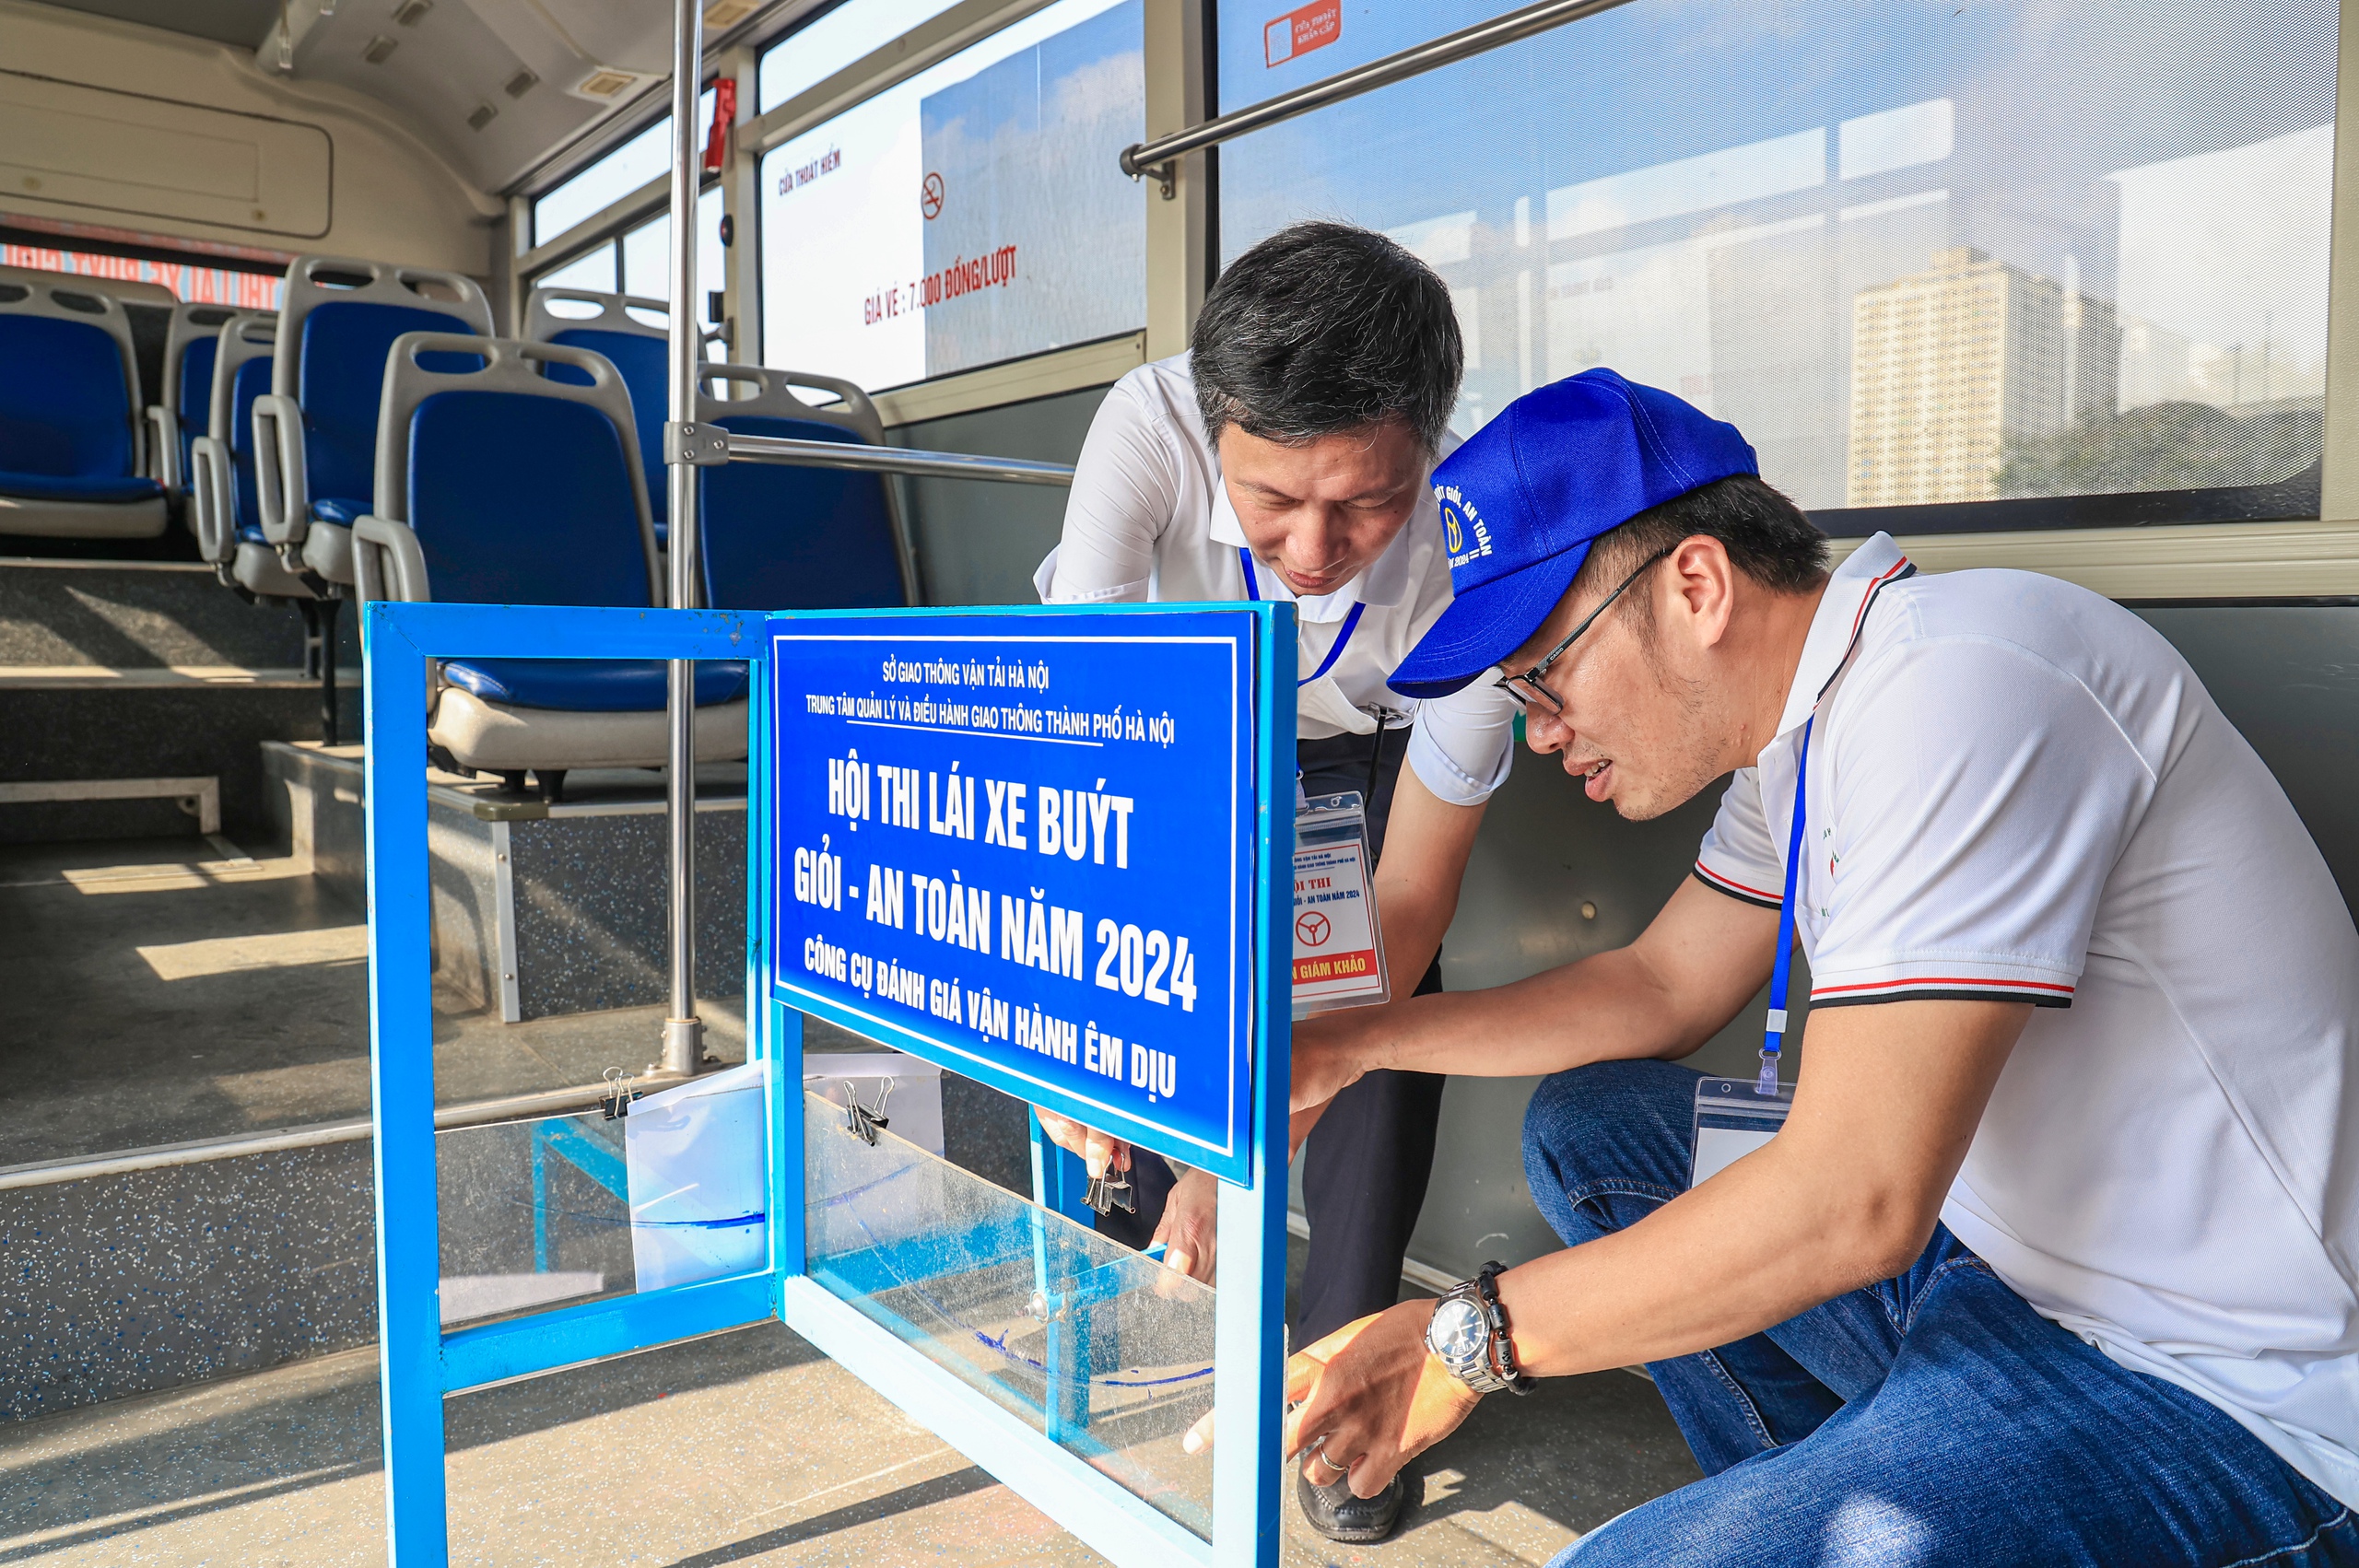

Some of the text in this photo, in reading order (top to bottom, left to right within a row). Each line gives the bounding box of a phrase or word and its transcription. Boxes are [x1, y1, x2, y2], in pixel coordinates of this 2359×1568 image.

[864, 287, 882, 325] GIÁ
[909, 273, 941, 310] 7.000
[1462, 500, 1478, 522] AN
[1473, 519, 1493, 556] TOÀN
[1454, 553, 1470, 568] 2024
[883, 653, 1050, 695] SỞ GIAO THÔNG VẬN TẢI HÀ NỘI
[805, 691, 1175, 749] TRUNG TÂM QUẢN LÝ VÀ ĐIỀU HÀNH GIAO THÔNG THÀNH PHỐ HÀ NỘI
[827, 748, 1134, 870] HỘI THI LÁI XE BUÝT
[1294, 877, 1332, 894] ỘI THI
[1308, 895, 1316, 904] AN
[1317, 892, 1331, 903] TOÀN
[1332, 890, 1345, 901] NĂM
[1346, 890, 1360, 899] 2024
[794, 834, 1198, 1013] GIỎI - AN TOÀN NĂM 2024
[1300, 961, 1332, 979] GIÁM
[1333, 954, 1367, 975] KHẢO
[804, 934, 1176, 1103] CÔNG CỤ ĐÁNH GIÁ VẬN HÀNH ÊM DỊU
